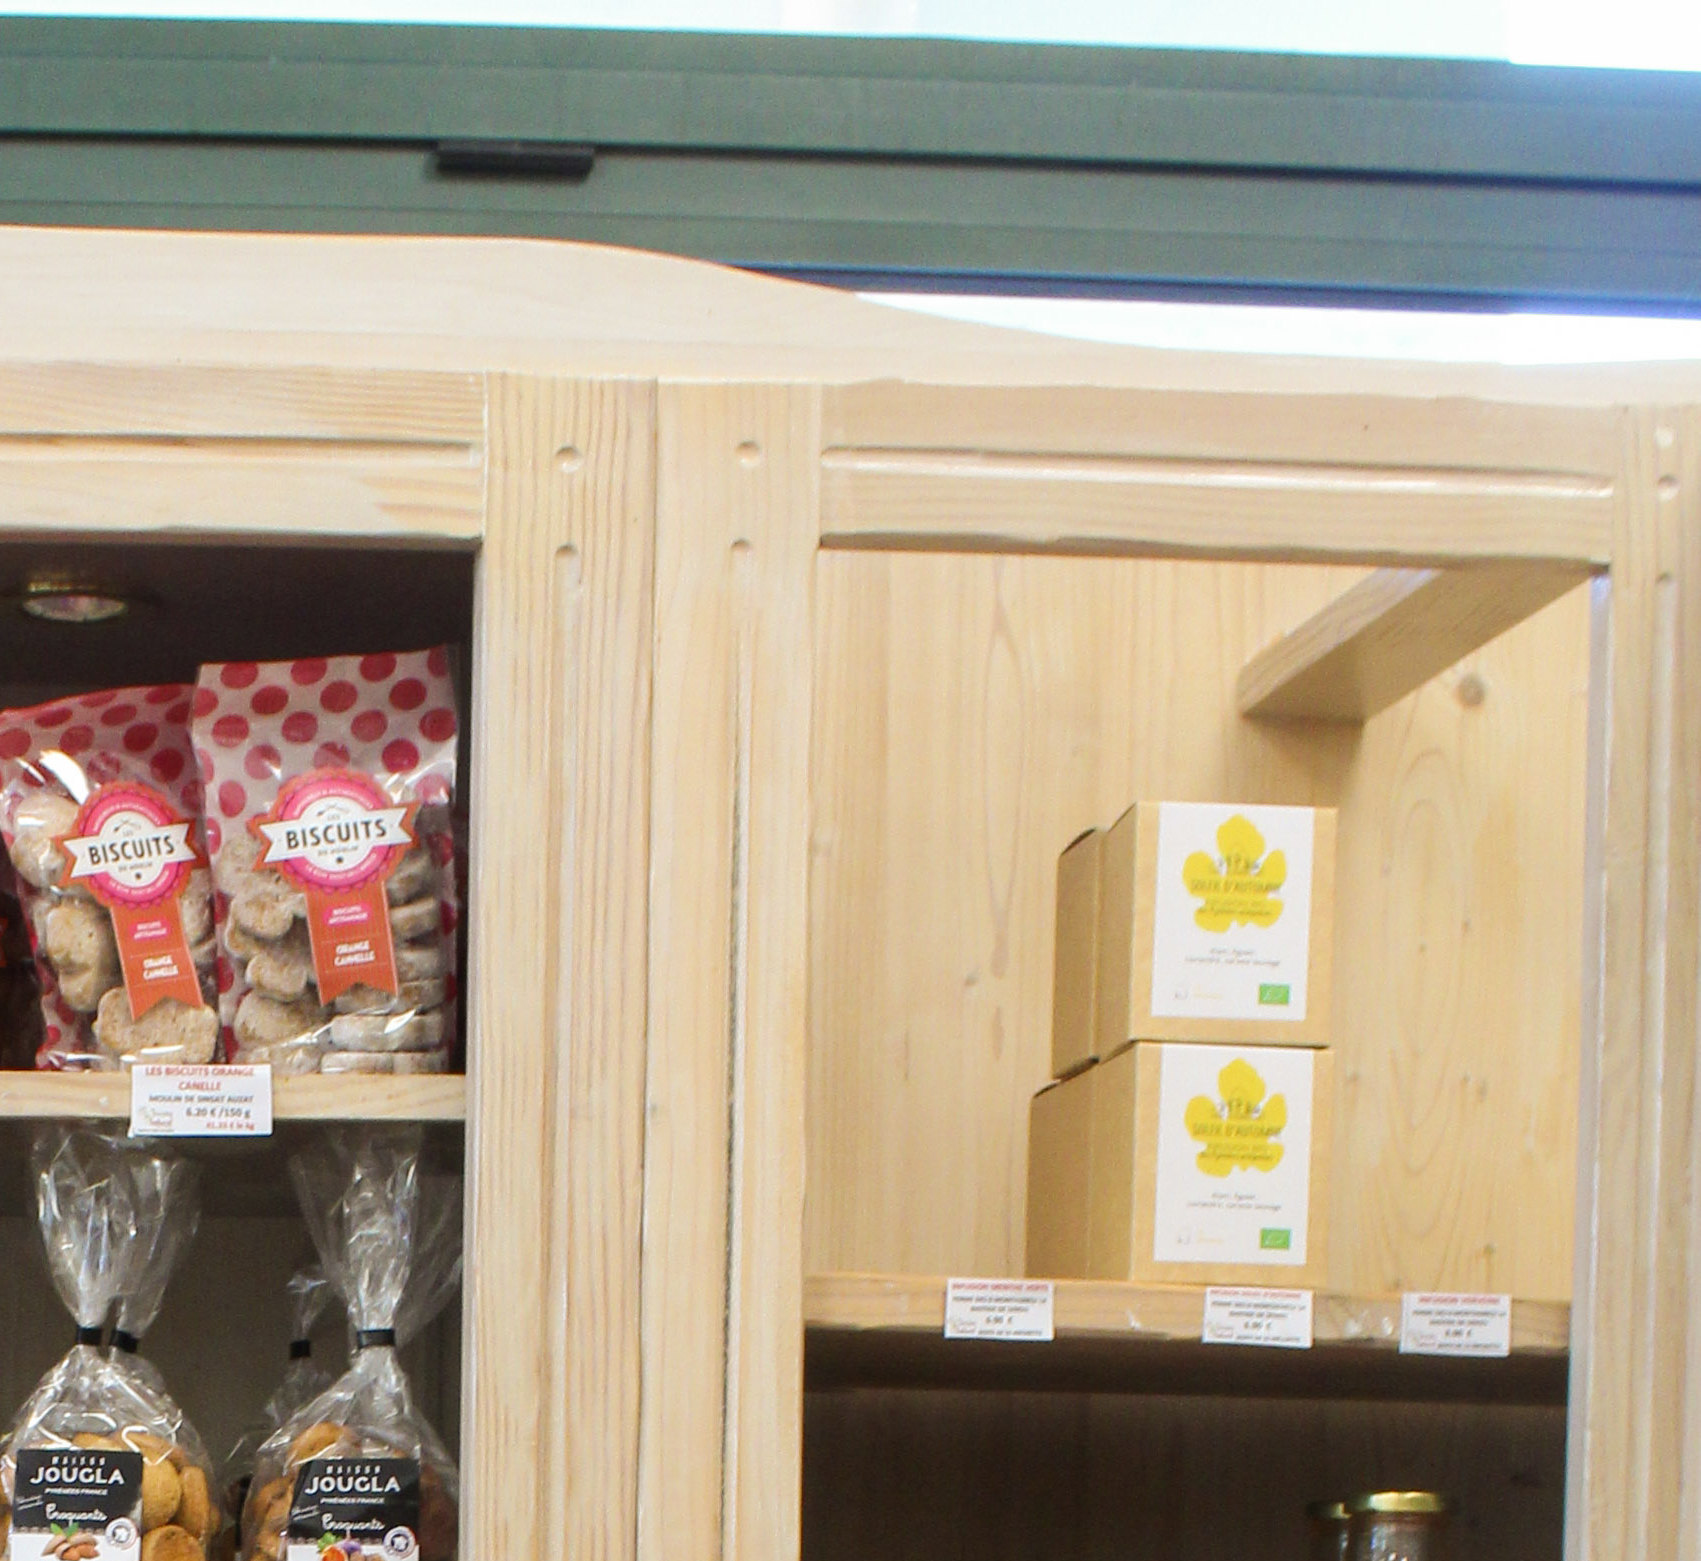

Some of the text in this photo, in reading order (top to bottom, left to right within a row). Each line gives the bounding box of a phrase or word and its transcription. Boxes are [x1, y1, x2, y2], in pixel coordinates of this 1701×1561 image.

[286, 819, 387, 850] BISCUITS
[88, 834, 175, 865] BISCUITS
[30, 1467, 124, 1485] JOUGLA
[304, 1476, 400, 1494] JOUGLA
